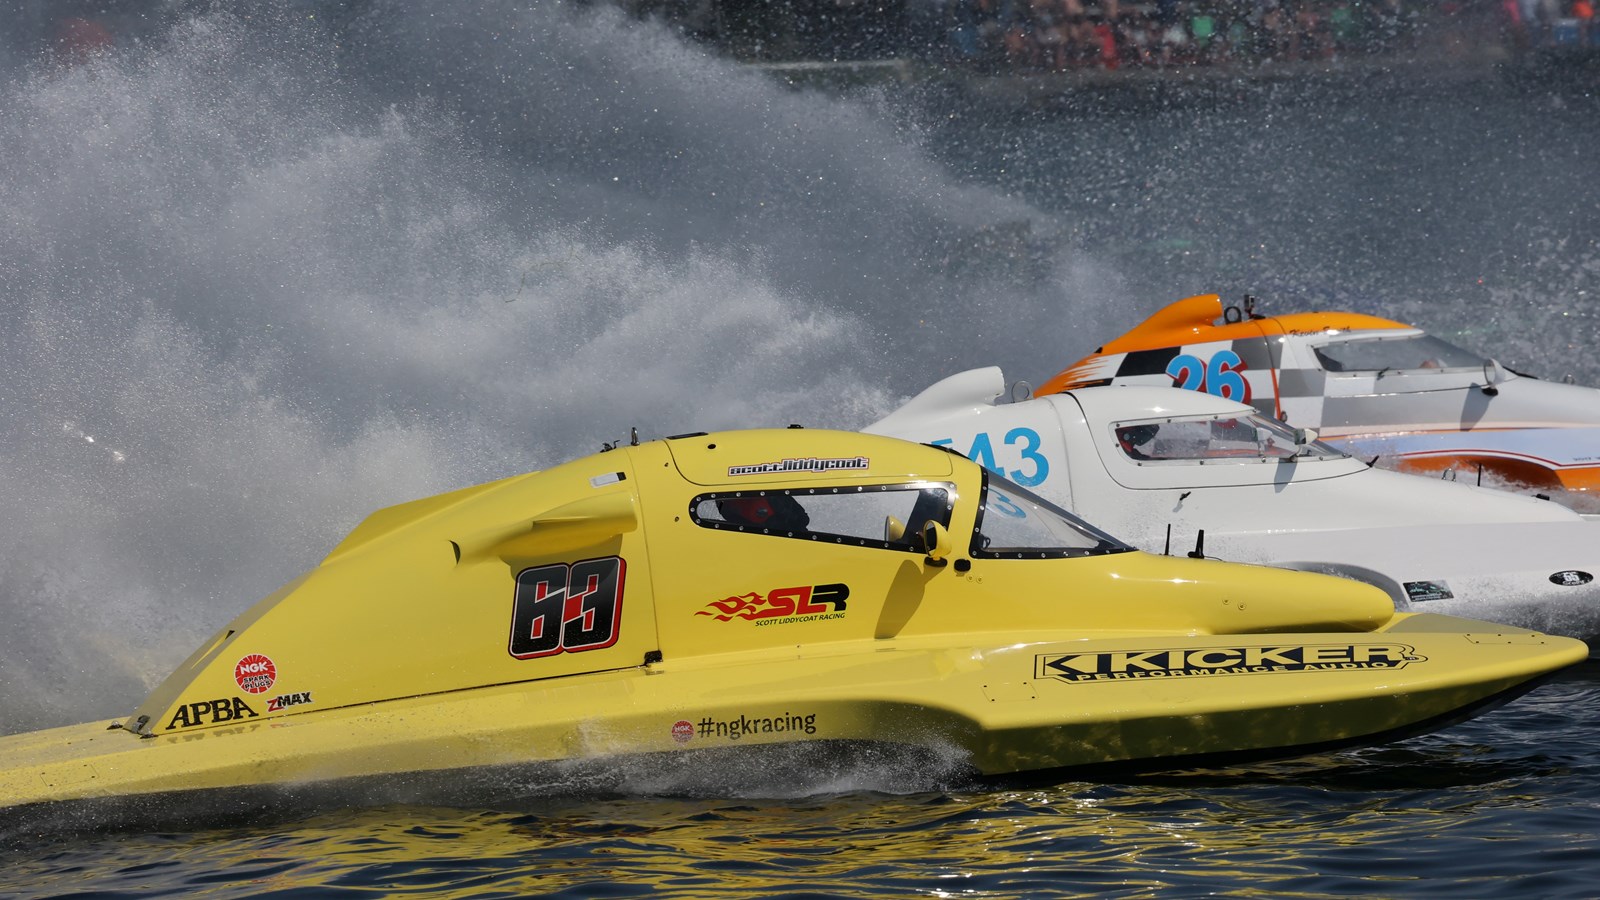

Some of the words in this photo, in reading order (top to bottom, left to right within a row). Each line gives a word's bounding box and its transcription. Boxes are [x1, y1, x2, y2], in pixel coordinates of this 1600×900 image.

[1166, 350, 1251, 404] 26
[508, 555, 627, 660] 63
[762, 583, 850, 618] SLR
[755, 618, 778, 627] SCOTT
[778, 615, 818, 625] LIDDYCOAT
[818, 612, 846, 621] RACING
[240, 660, 269, 675] NGK
[243, 674, 270, 684] SPARK
[1076, 665, 1287, 681] PERFORMANCE
[1303, 661, 1389, 671] AUDIO
[244, 680, 271, 690] PLUGS
[165, 696, 259, 730] APBA
[697, 712, 816, 740] #ngkracing
